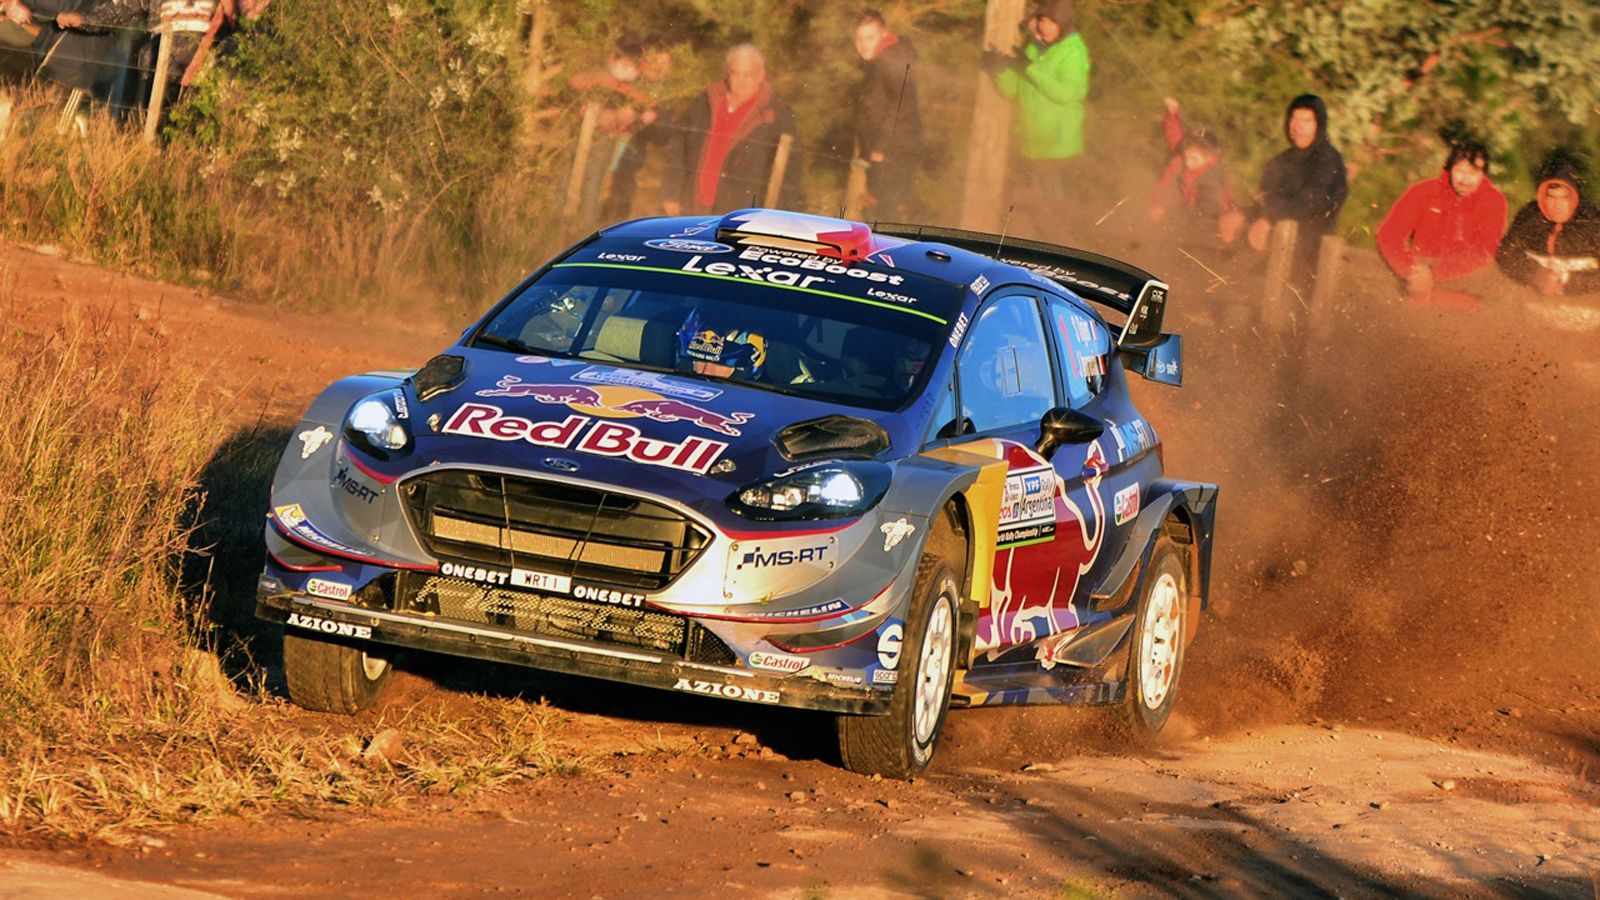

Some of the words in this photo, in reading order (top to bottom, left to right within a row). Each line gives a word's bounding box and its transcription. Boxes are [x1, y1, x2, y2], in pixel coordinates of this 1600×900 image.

[658, 239, 720, 252] Ford
[746, 245, 822, 261] Powered
[822, 256, 844, 265] by
[597, 251, 647, 262] Lexar
[738, 250, 904, 286] EcoBoost
[866, 287, 918, 305] Lexar
[949, 312, 969, 348] ONEBET
[442, 402, 590, 449] Red
[575, 420, 728, 475] Bull
[1025, 478, 1041, 493] YPF
[317, 582, 348, 598] Castrol
[441, 562, 509, 585] ONEBET
[524, 573, 548, 588] WRT
[573, 585, 646, 607] ONEBET
[286, 613, 372, 639] AZIONE
[762, 655, 806, 671] Castrol
[673, 679, 781, 704] AZIONE
